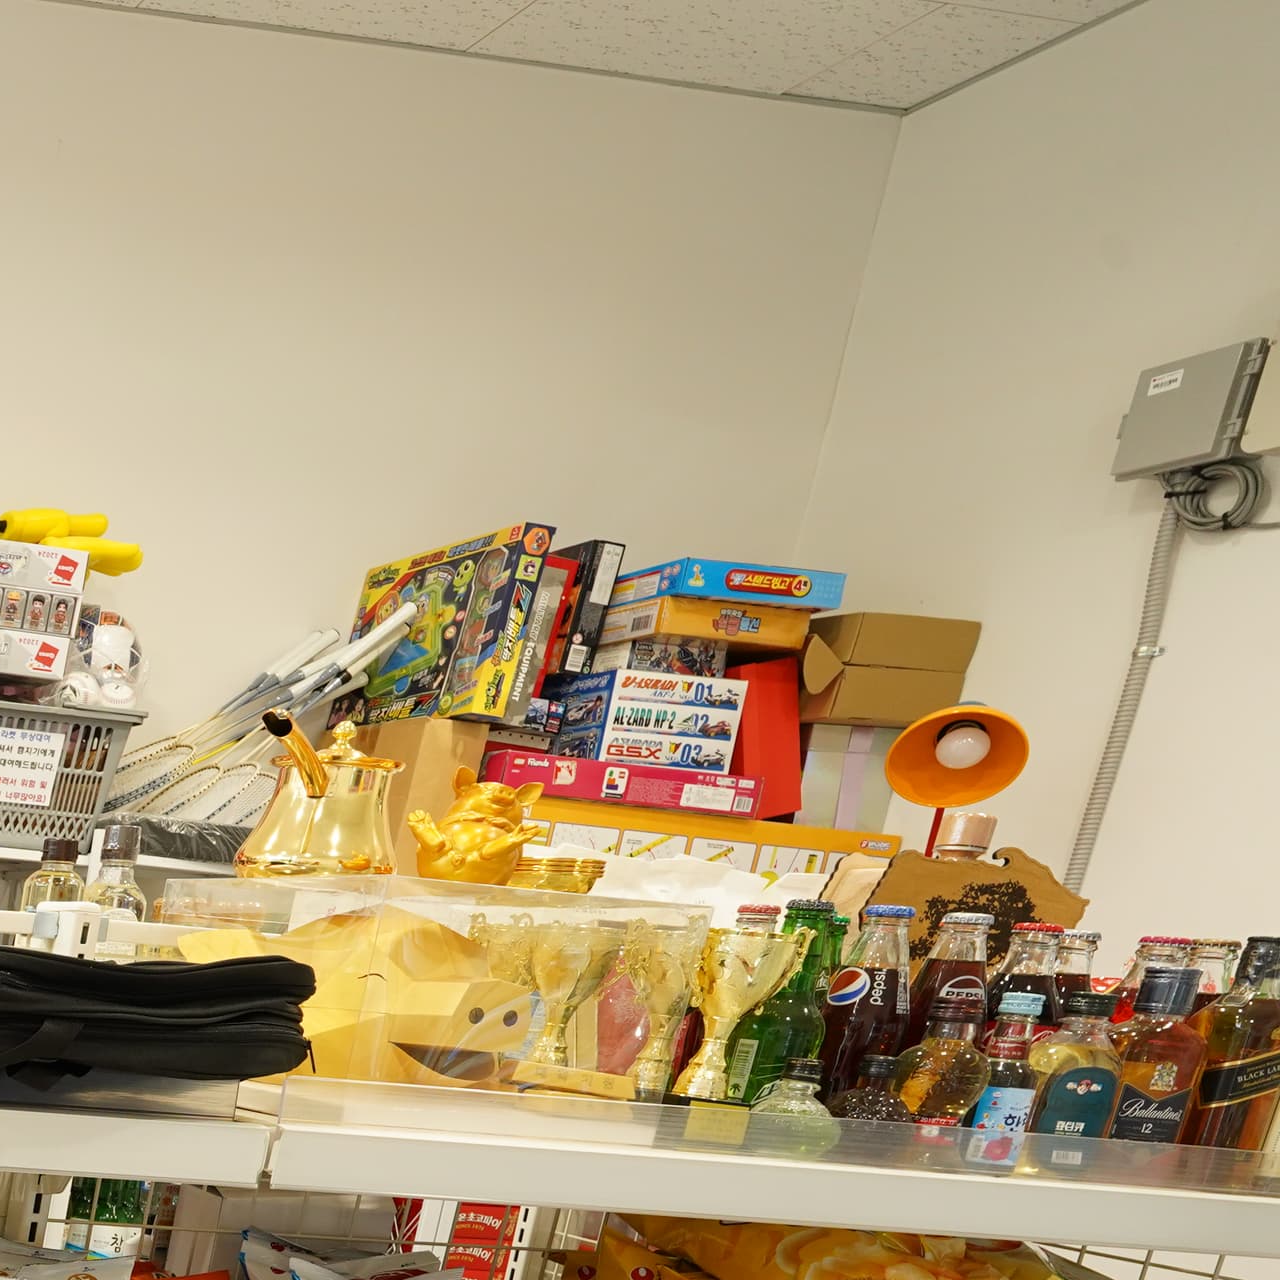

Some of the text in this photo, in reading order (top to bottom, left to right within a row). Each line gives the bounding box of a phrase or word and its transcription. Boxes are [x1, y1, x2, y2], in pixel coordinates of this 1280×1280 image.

[511, 641, 537, 702] EQUIPMENT
[606, 744, 662, 760] GSX
[868, 967, 887, 1007] pepsi
[1236, 1069, 1266, 1083] BLACK
